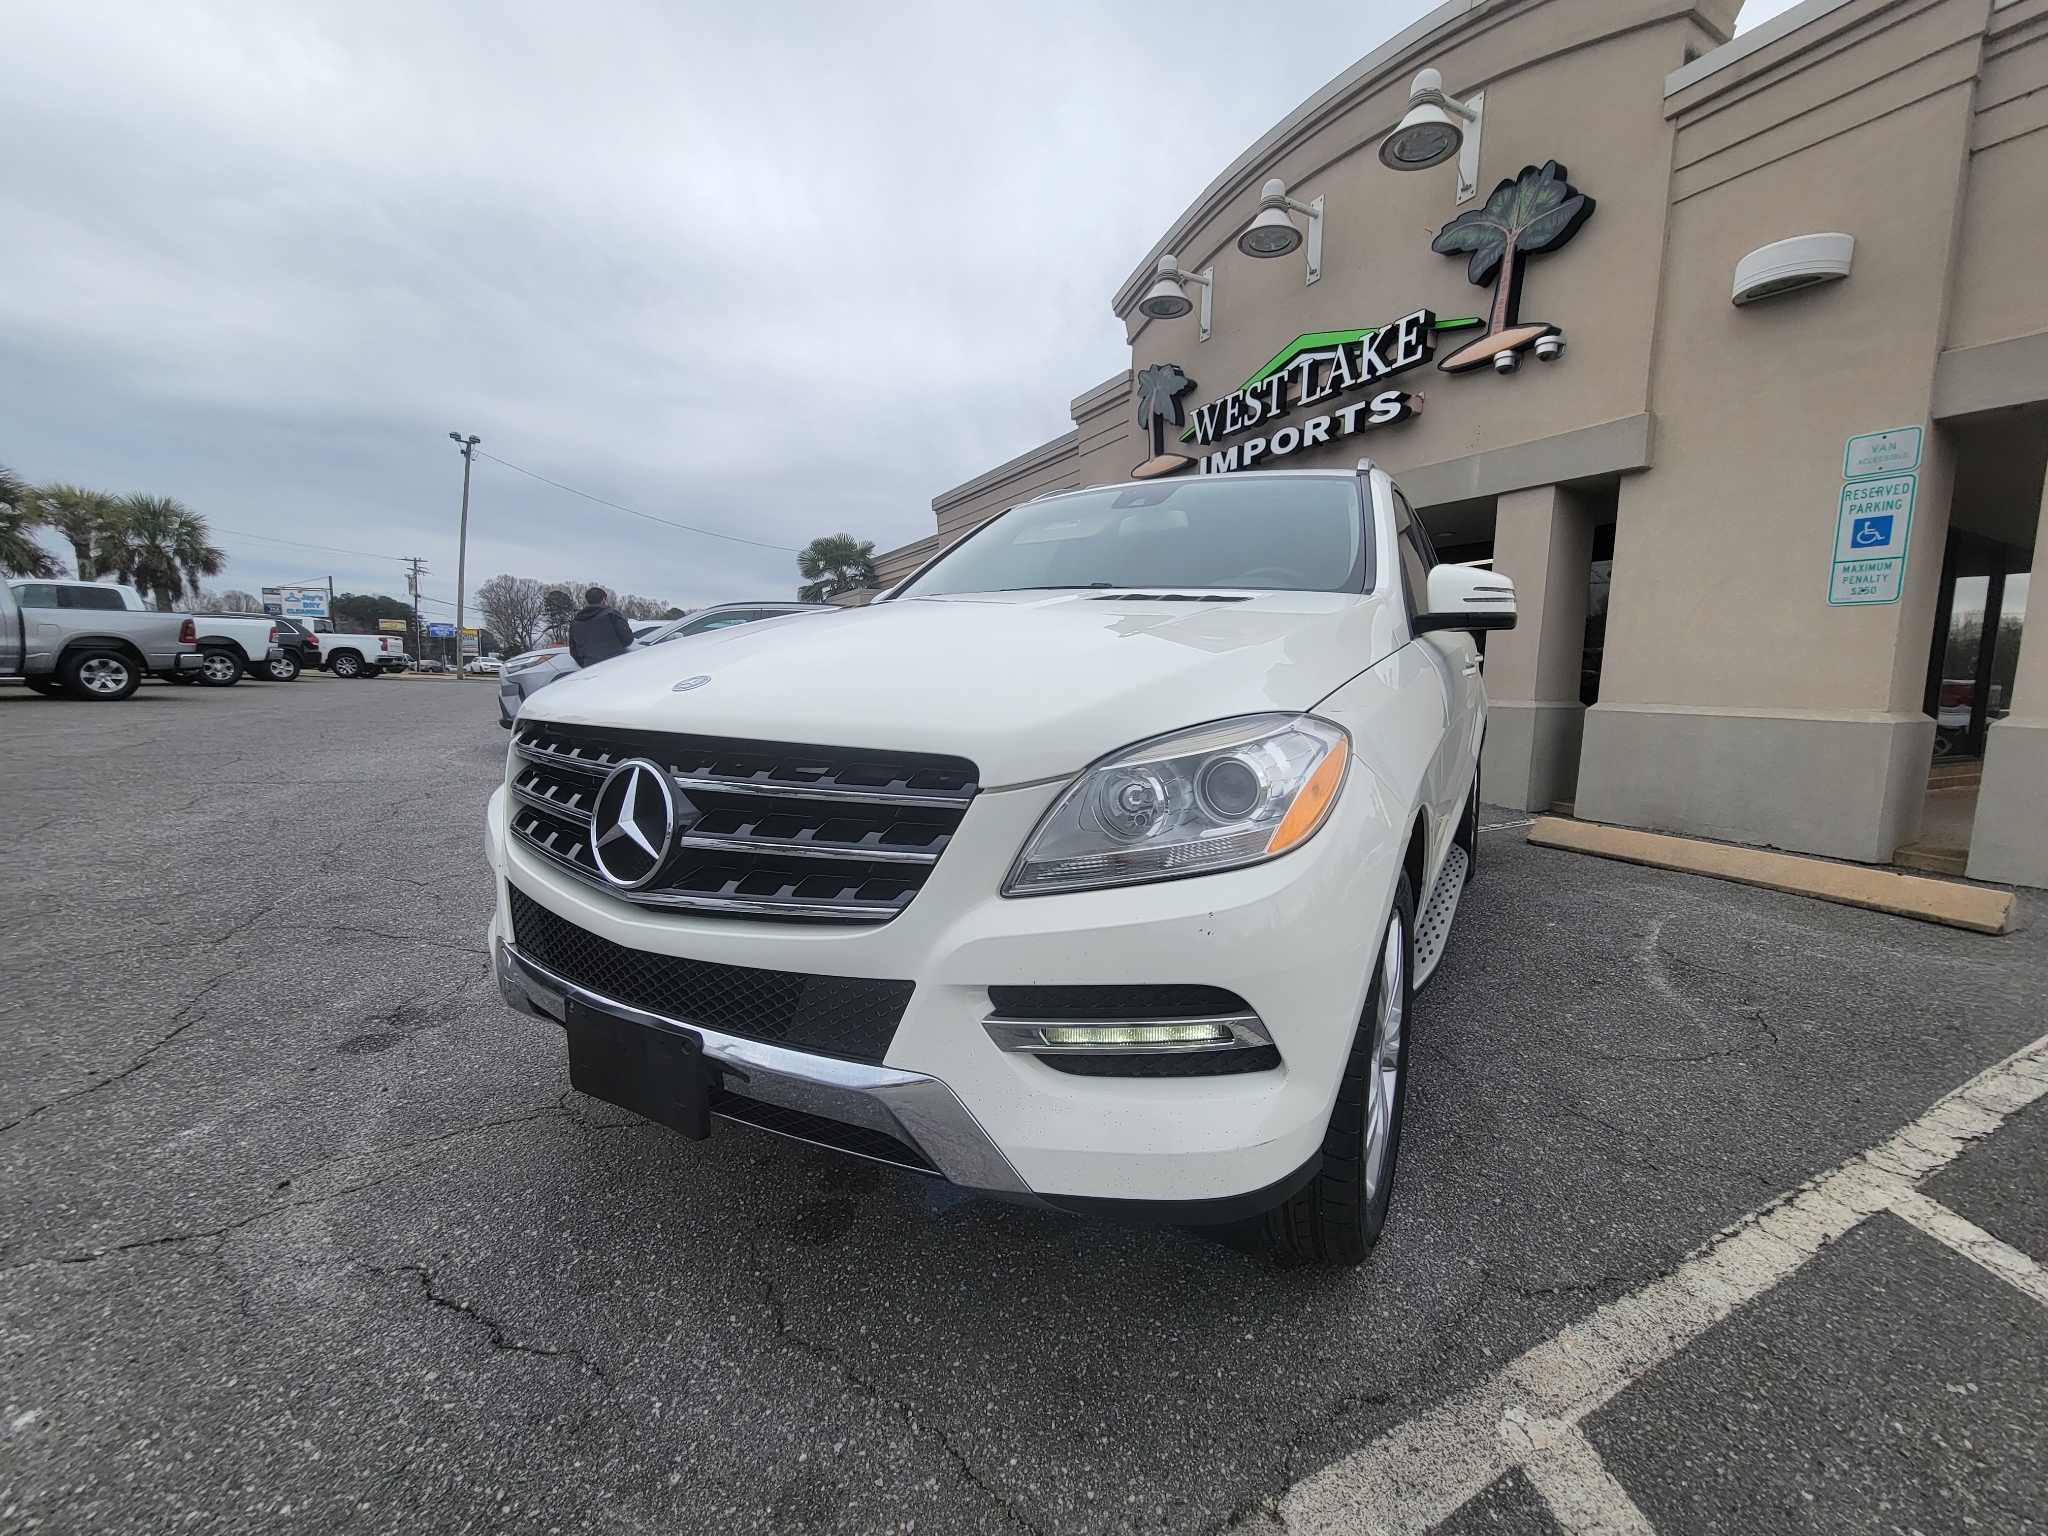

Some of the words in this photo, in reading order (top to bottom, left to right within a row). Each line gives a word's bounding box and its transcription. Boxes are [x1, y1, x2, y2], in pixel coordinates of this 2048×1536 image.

[1189, 369, 1290, 445] WEST
[1297, 308, 1430, 406] LAKE
[1200, 390, 1404, 475] IMPORTS
[1871, 442, 1897, 454] VAN
[1857, 452, 1908, 465] ACCESSIBLE
[1845, 482, 1910, 501] RESERVED
[1848, 499, 1903, 515] PARKING
[1842, 562, 1893, 574] MAXIMUM
[1842, 574, 1890, 585] PENALTY
[1850, 586, 1877, 596] $250
